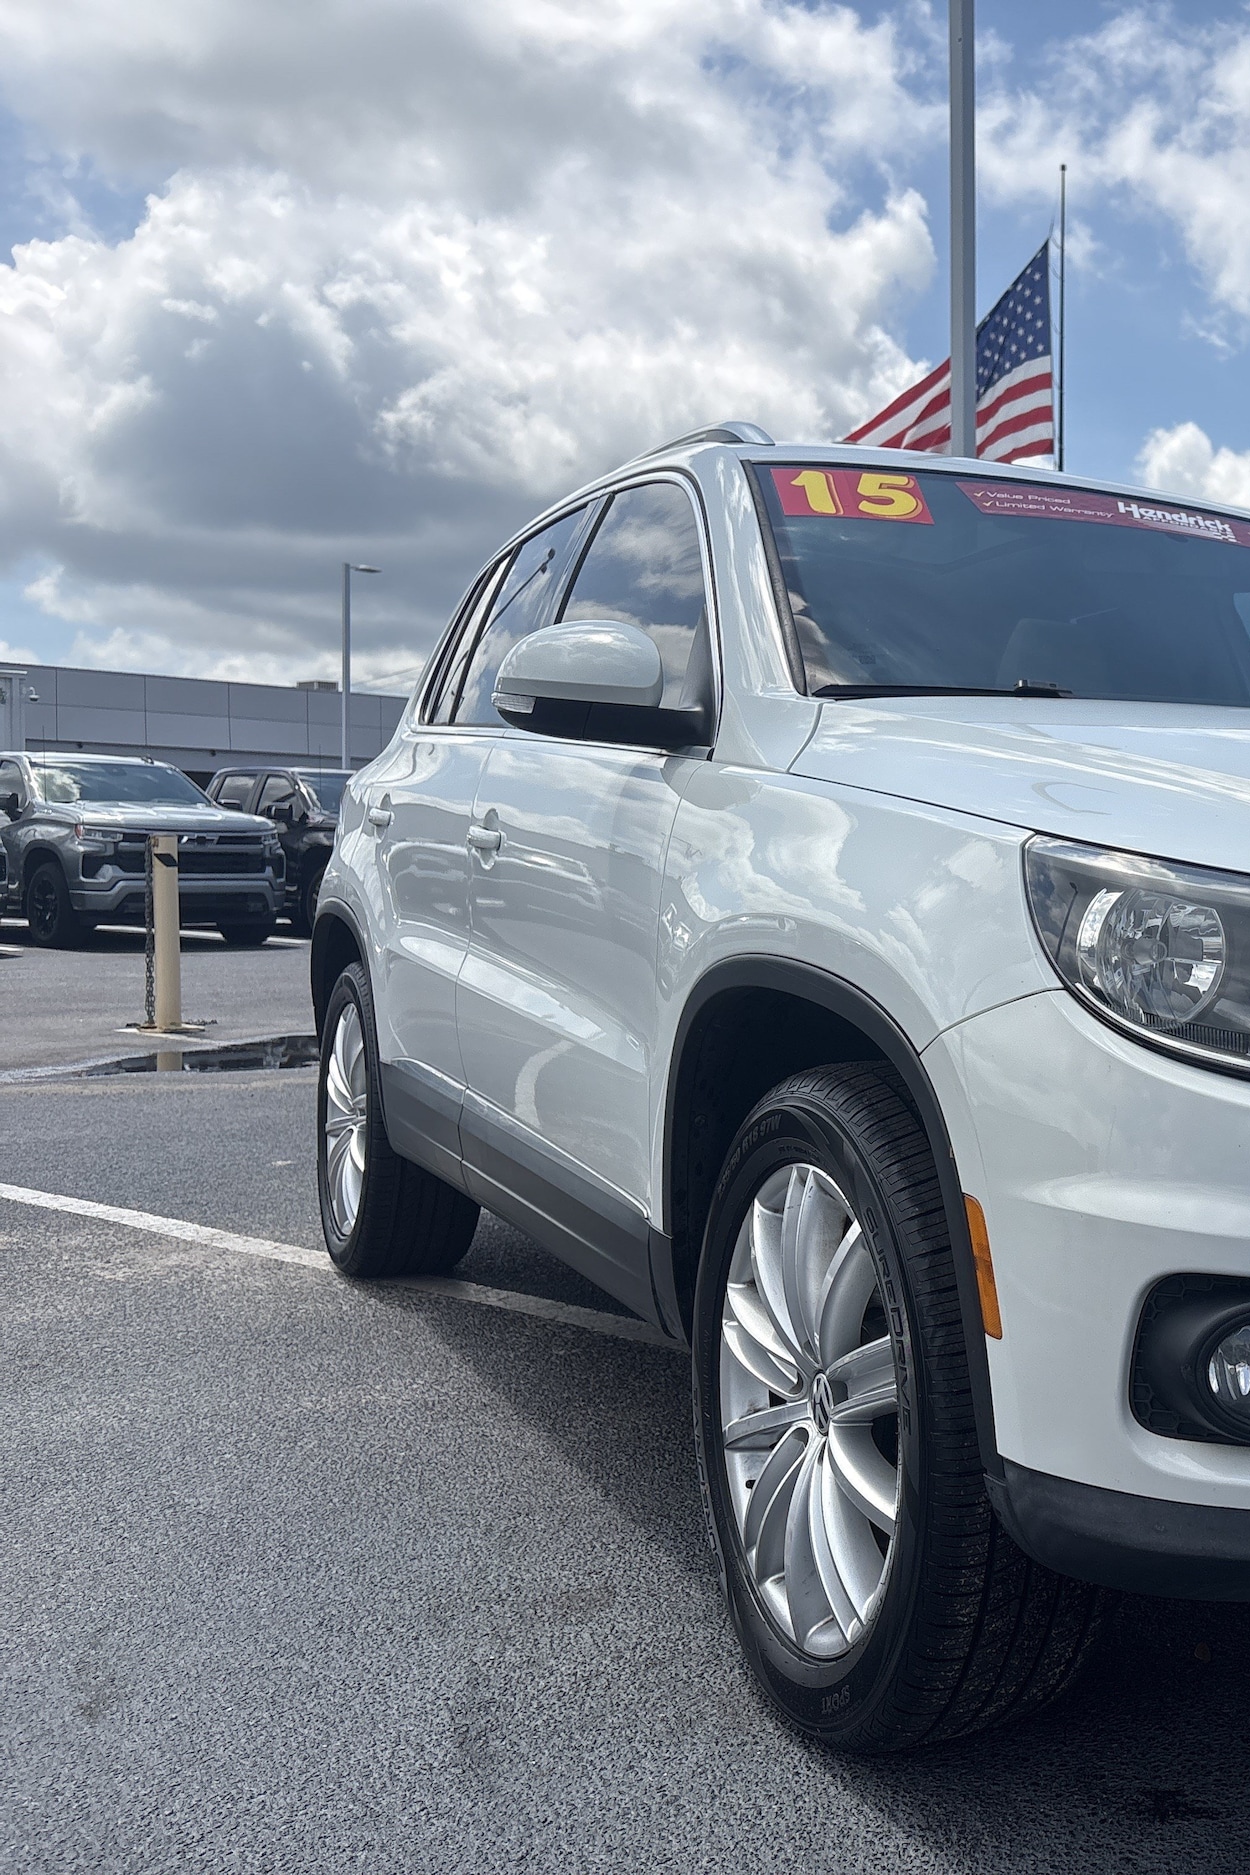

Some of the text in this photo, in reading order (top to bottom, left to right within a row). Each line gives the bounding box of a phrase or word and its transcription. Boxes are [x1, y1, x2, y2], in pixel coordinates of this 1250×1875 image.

[790, 470, 923, 519] 15
[986, 490, 1071, 505] Value Priced
[995, 500, 1046, 510] Limited
[1049, 505, 1115, 518] Warranty
[1117, 501, 1232, 533] Hendrick
[863, 1206, 912, 1436] SUREDRIVE
